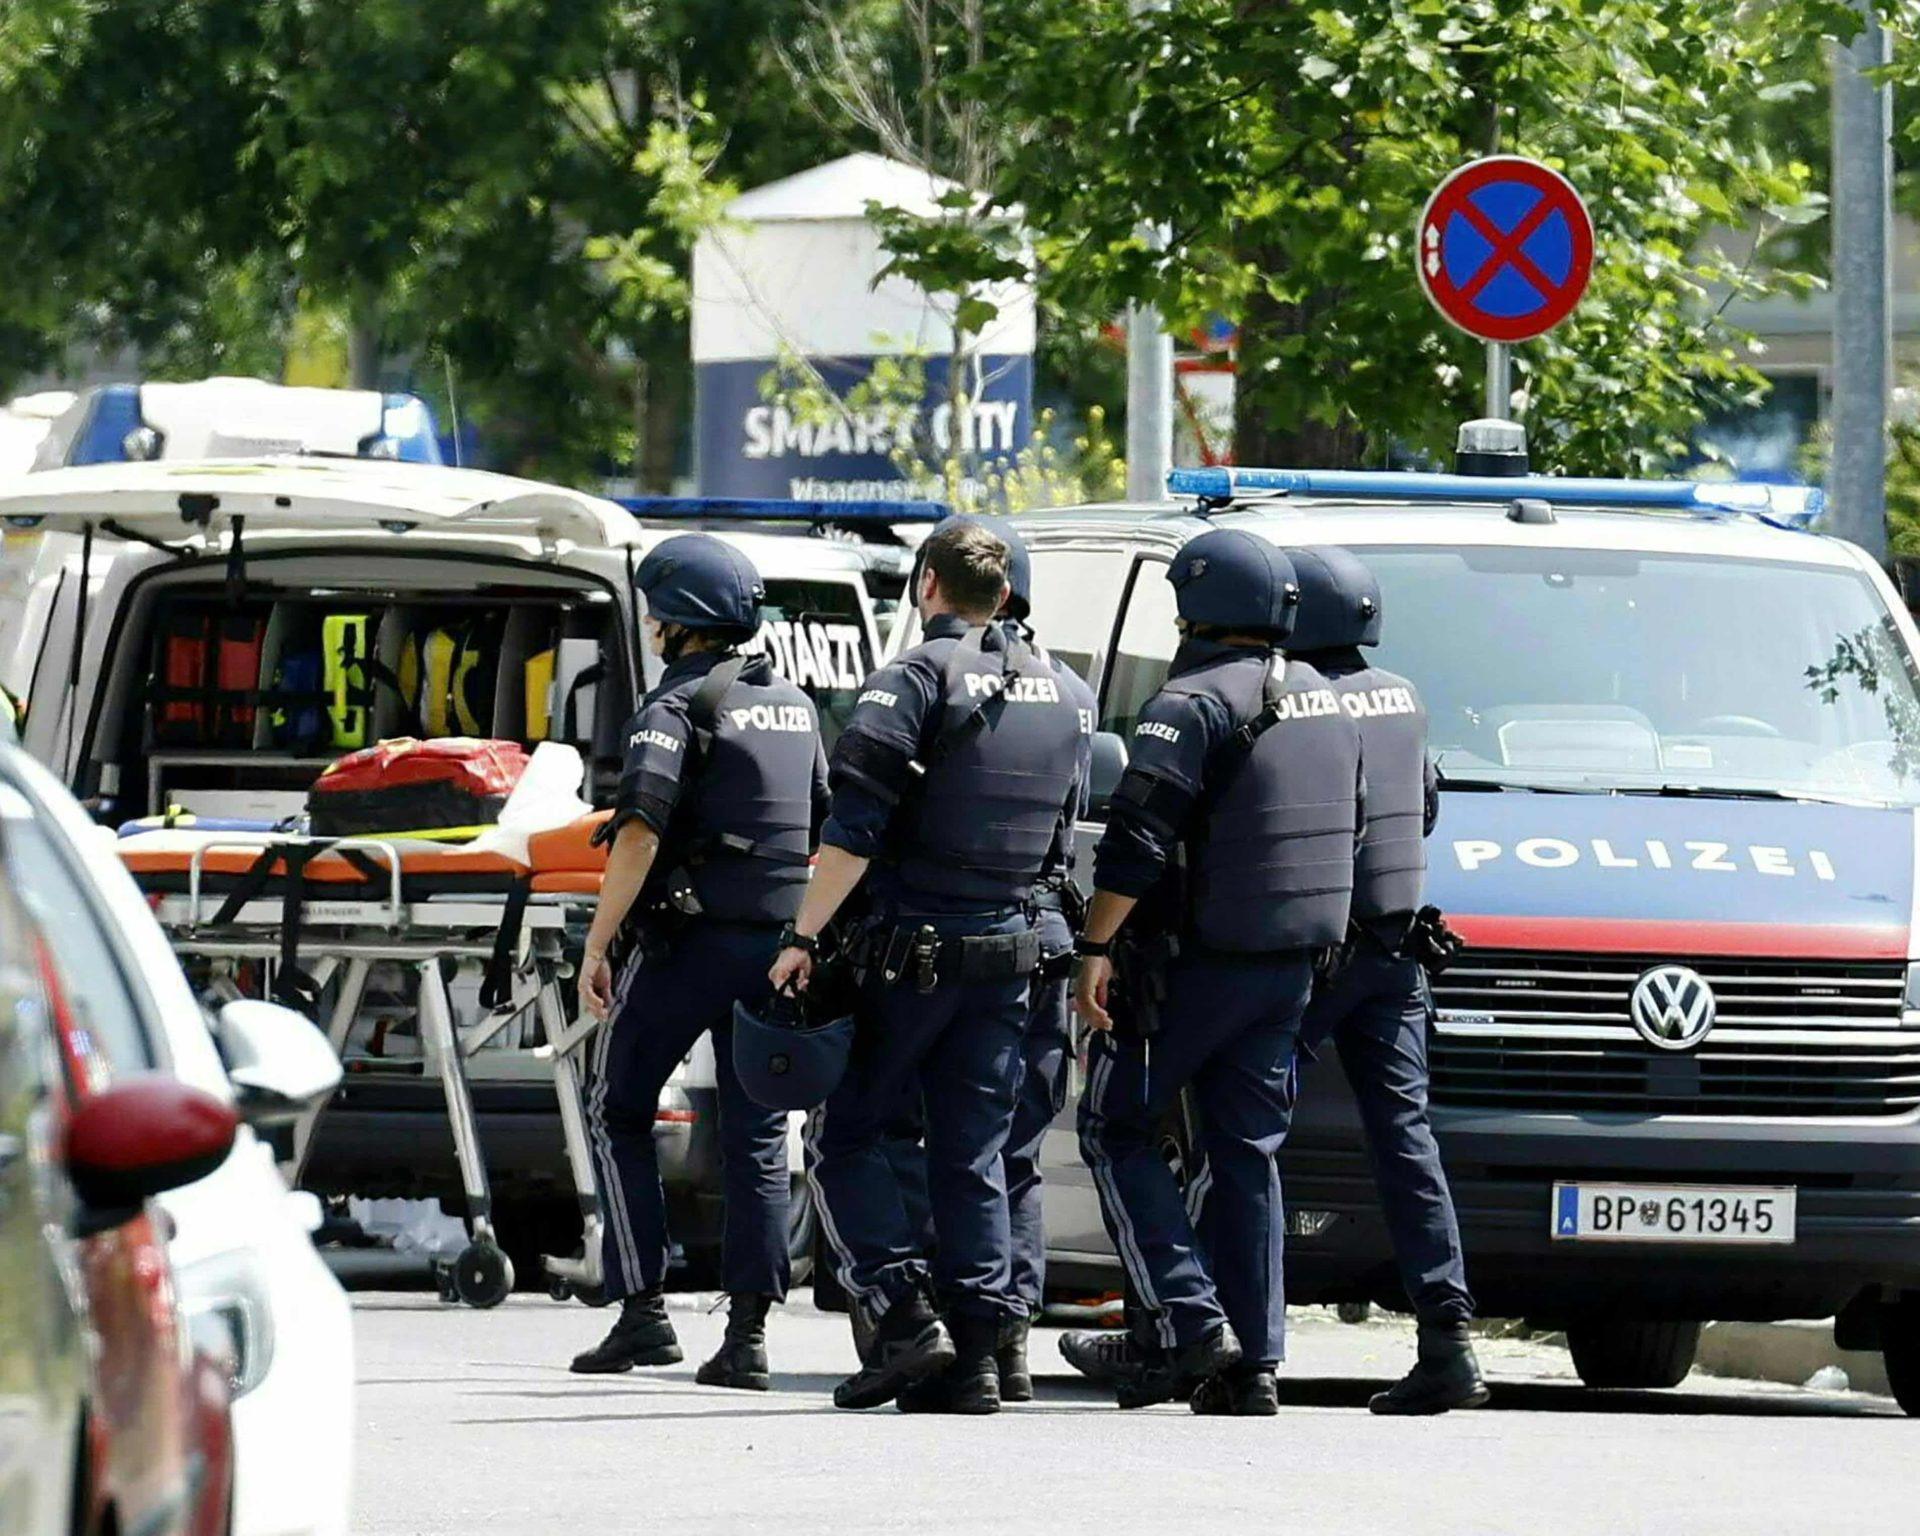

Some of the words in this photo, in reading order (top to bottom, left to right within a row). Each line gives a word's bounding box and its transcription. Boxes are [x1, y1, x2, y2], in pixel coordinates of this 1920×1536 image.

[744, 404, 919, 459] SMART
[932, 400, 1017, 451] CITY
[736, 619, 865, 690] OTARZT
[730, 704, 812, 732] POLIZEI
[1275, 688, 1340, 721] OLIZEI
[1341, 686, 1416, 719] OLIZEI
[629, 729, 679, 753] POLIZEI
[1452, 837, 1836, 881] POLIZEI
[1593, 1195, 1636, 1232] BP
[1666, 1197, 1774, 1234] 61345
